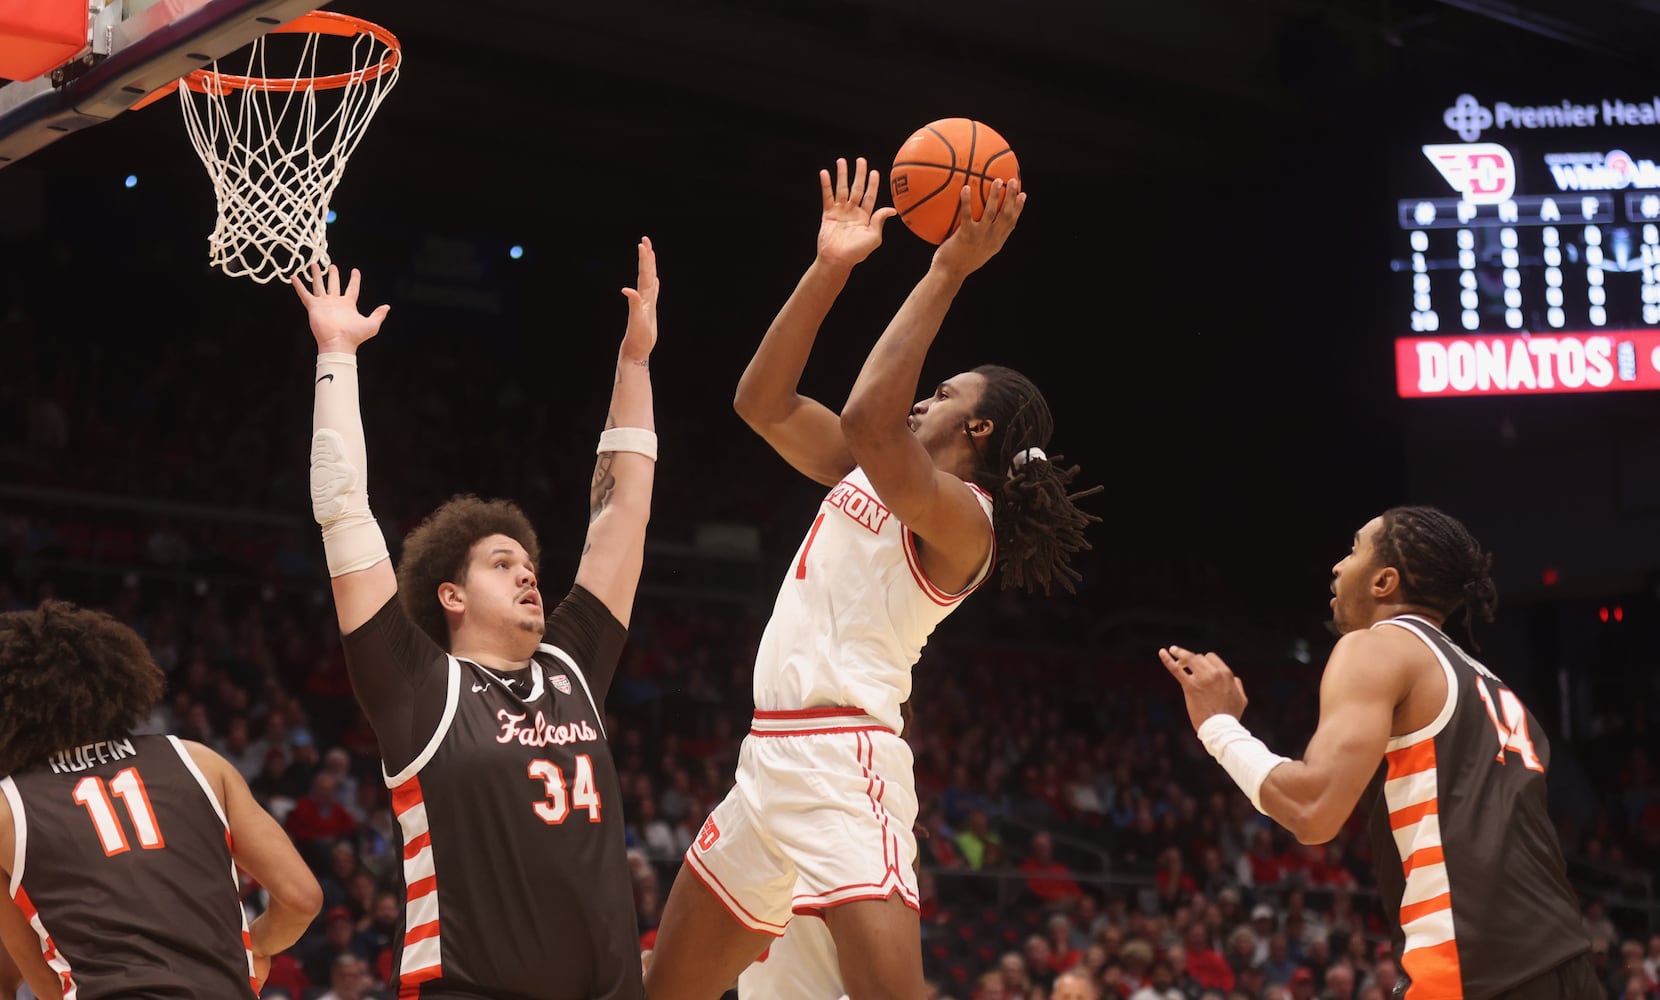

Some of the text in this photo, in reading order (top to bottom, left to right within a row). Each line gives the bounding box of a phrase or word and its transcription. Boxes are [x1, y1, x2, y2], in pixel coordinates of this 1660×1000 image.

[1494, 99, 1599, 129] Premier
[1416, 337, 1614, 393] DONATOS
[826, 481, 891, 535] TON
[796, 512, 826, 580] 1
[496, 708, 597, 748] Falcons
[1475, 675, 1544, 774] 14
[72, 766, 165, 857] 11
[528, 753, 601, 825] 34
